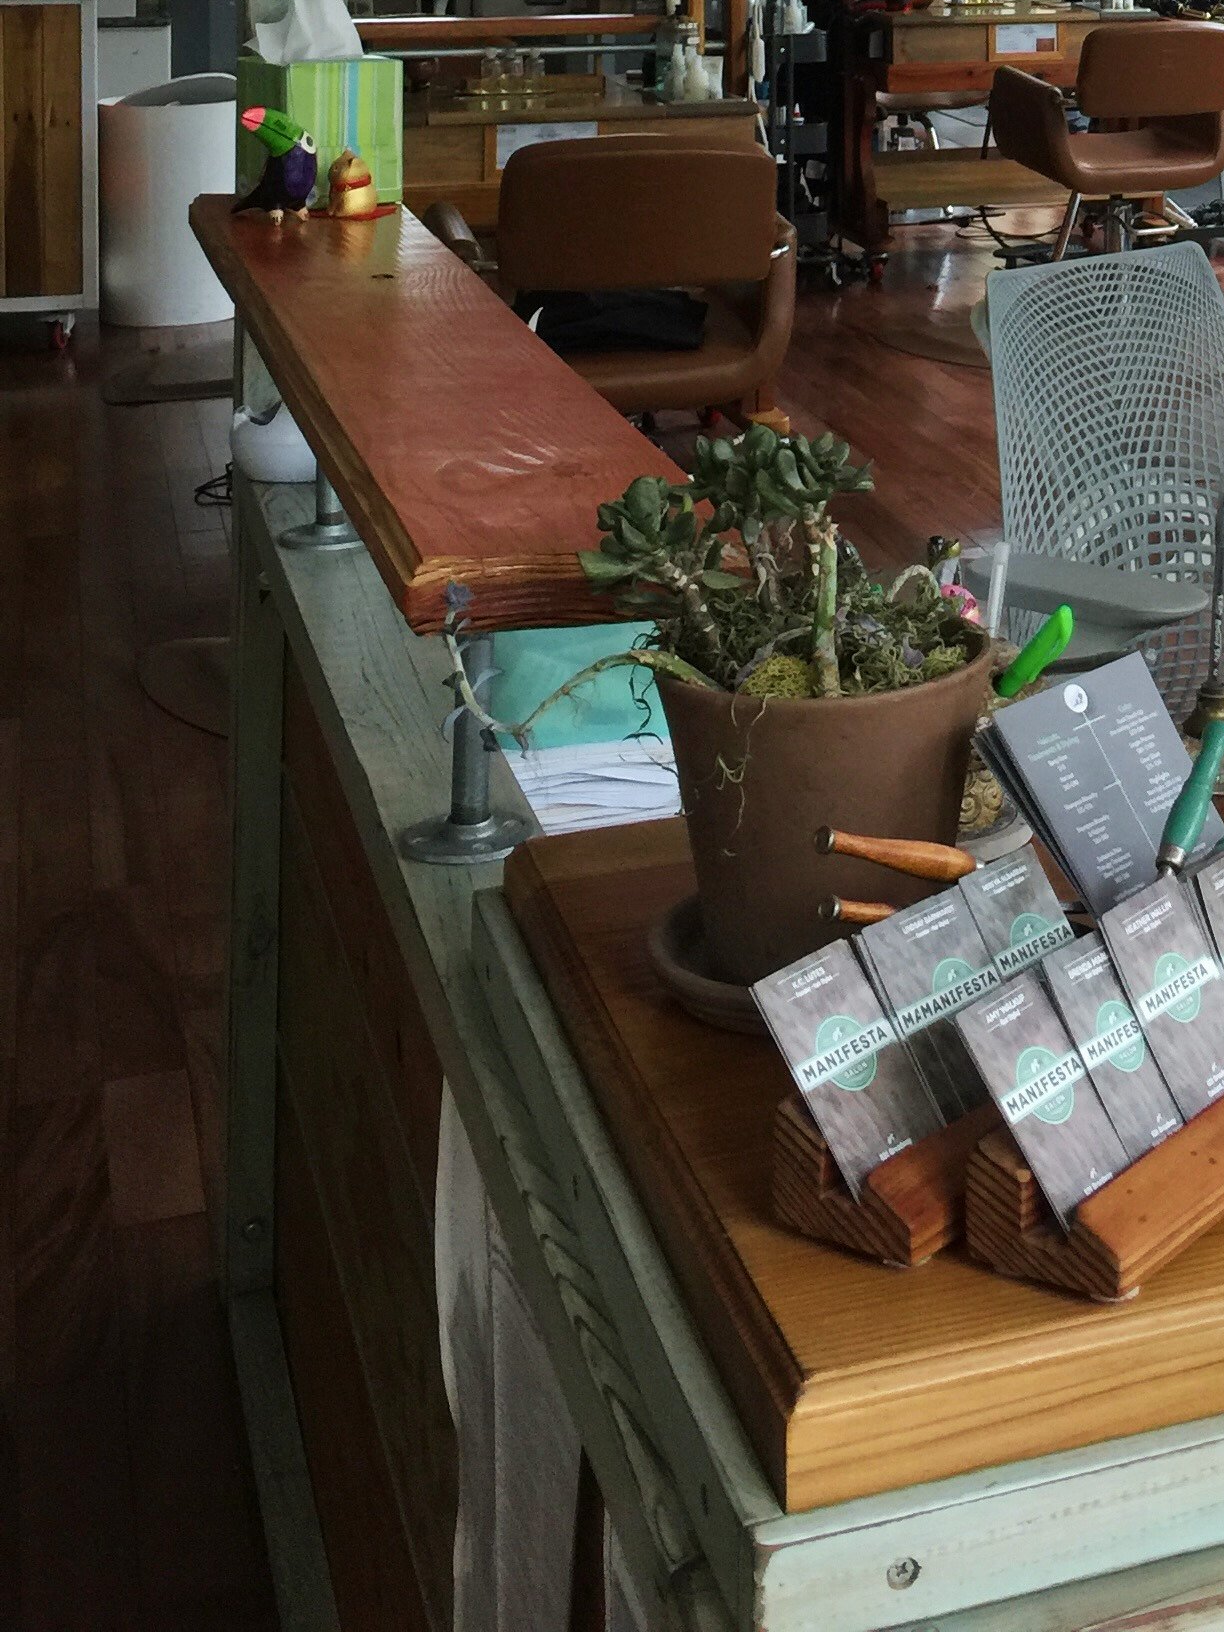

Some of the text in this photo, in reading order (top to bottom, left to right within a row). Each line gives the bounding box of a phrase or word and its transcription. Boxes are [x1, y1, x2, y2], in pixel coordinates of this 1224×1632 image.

[999, 923, 1073, 972] MANIFESTA
[1145, 962, 1208, 1013] MANIFESTA
[802, 1024, 888, 1082] MANIFESTA
[1005, 1056, 1083, 1117] MANIFESTA
